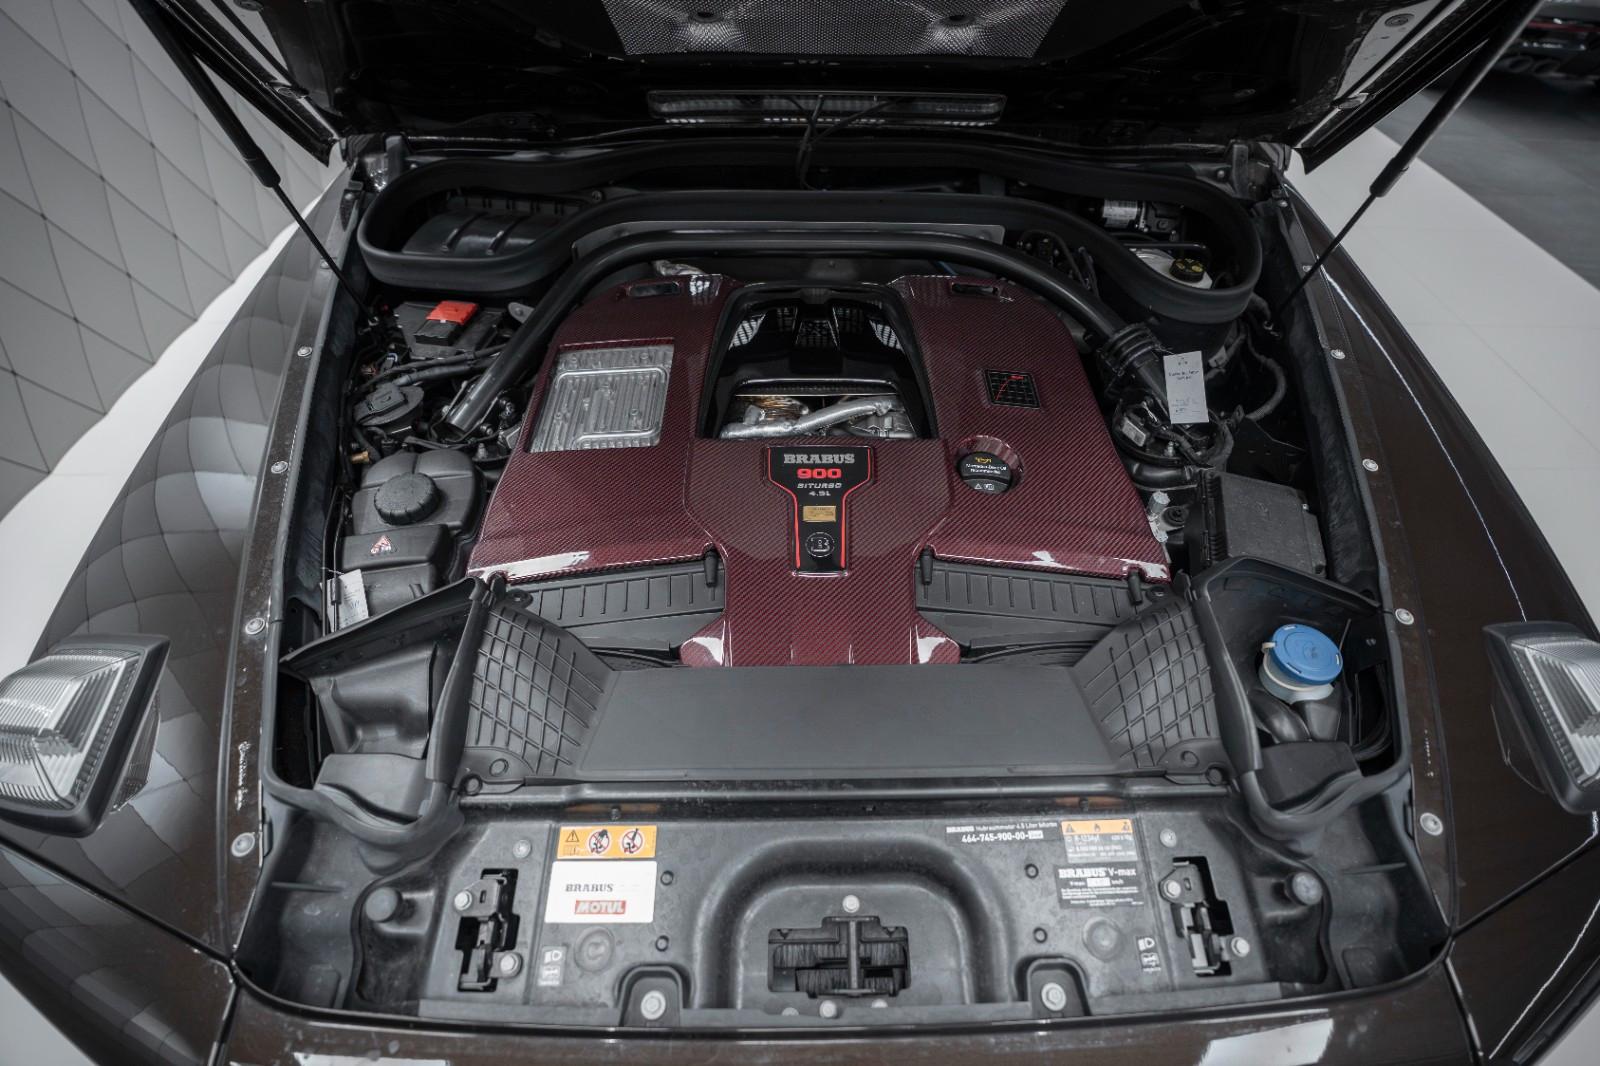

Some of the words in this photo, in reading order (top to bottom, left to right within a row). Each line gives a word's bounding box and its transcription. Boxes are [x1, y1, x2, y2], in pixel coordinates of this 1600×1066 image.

[783, 453, 855, 464] BRABUS
[797, 468, 842, 479] 900
[1058, 867, 1106, 878] BRABUS
[565, 883, 613, 892] BRABUS
[576, 901, 625, 914] MOTUL
